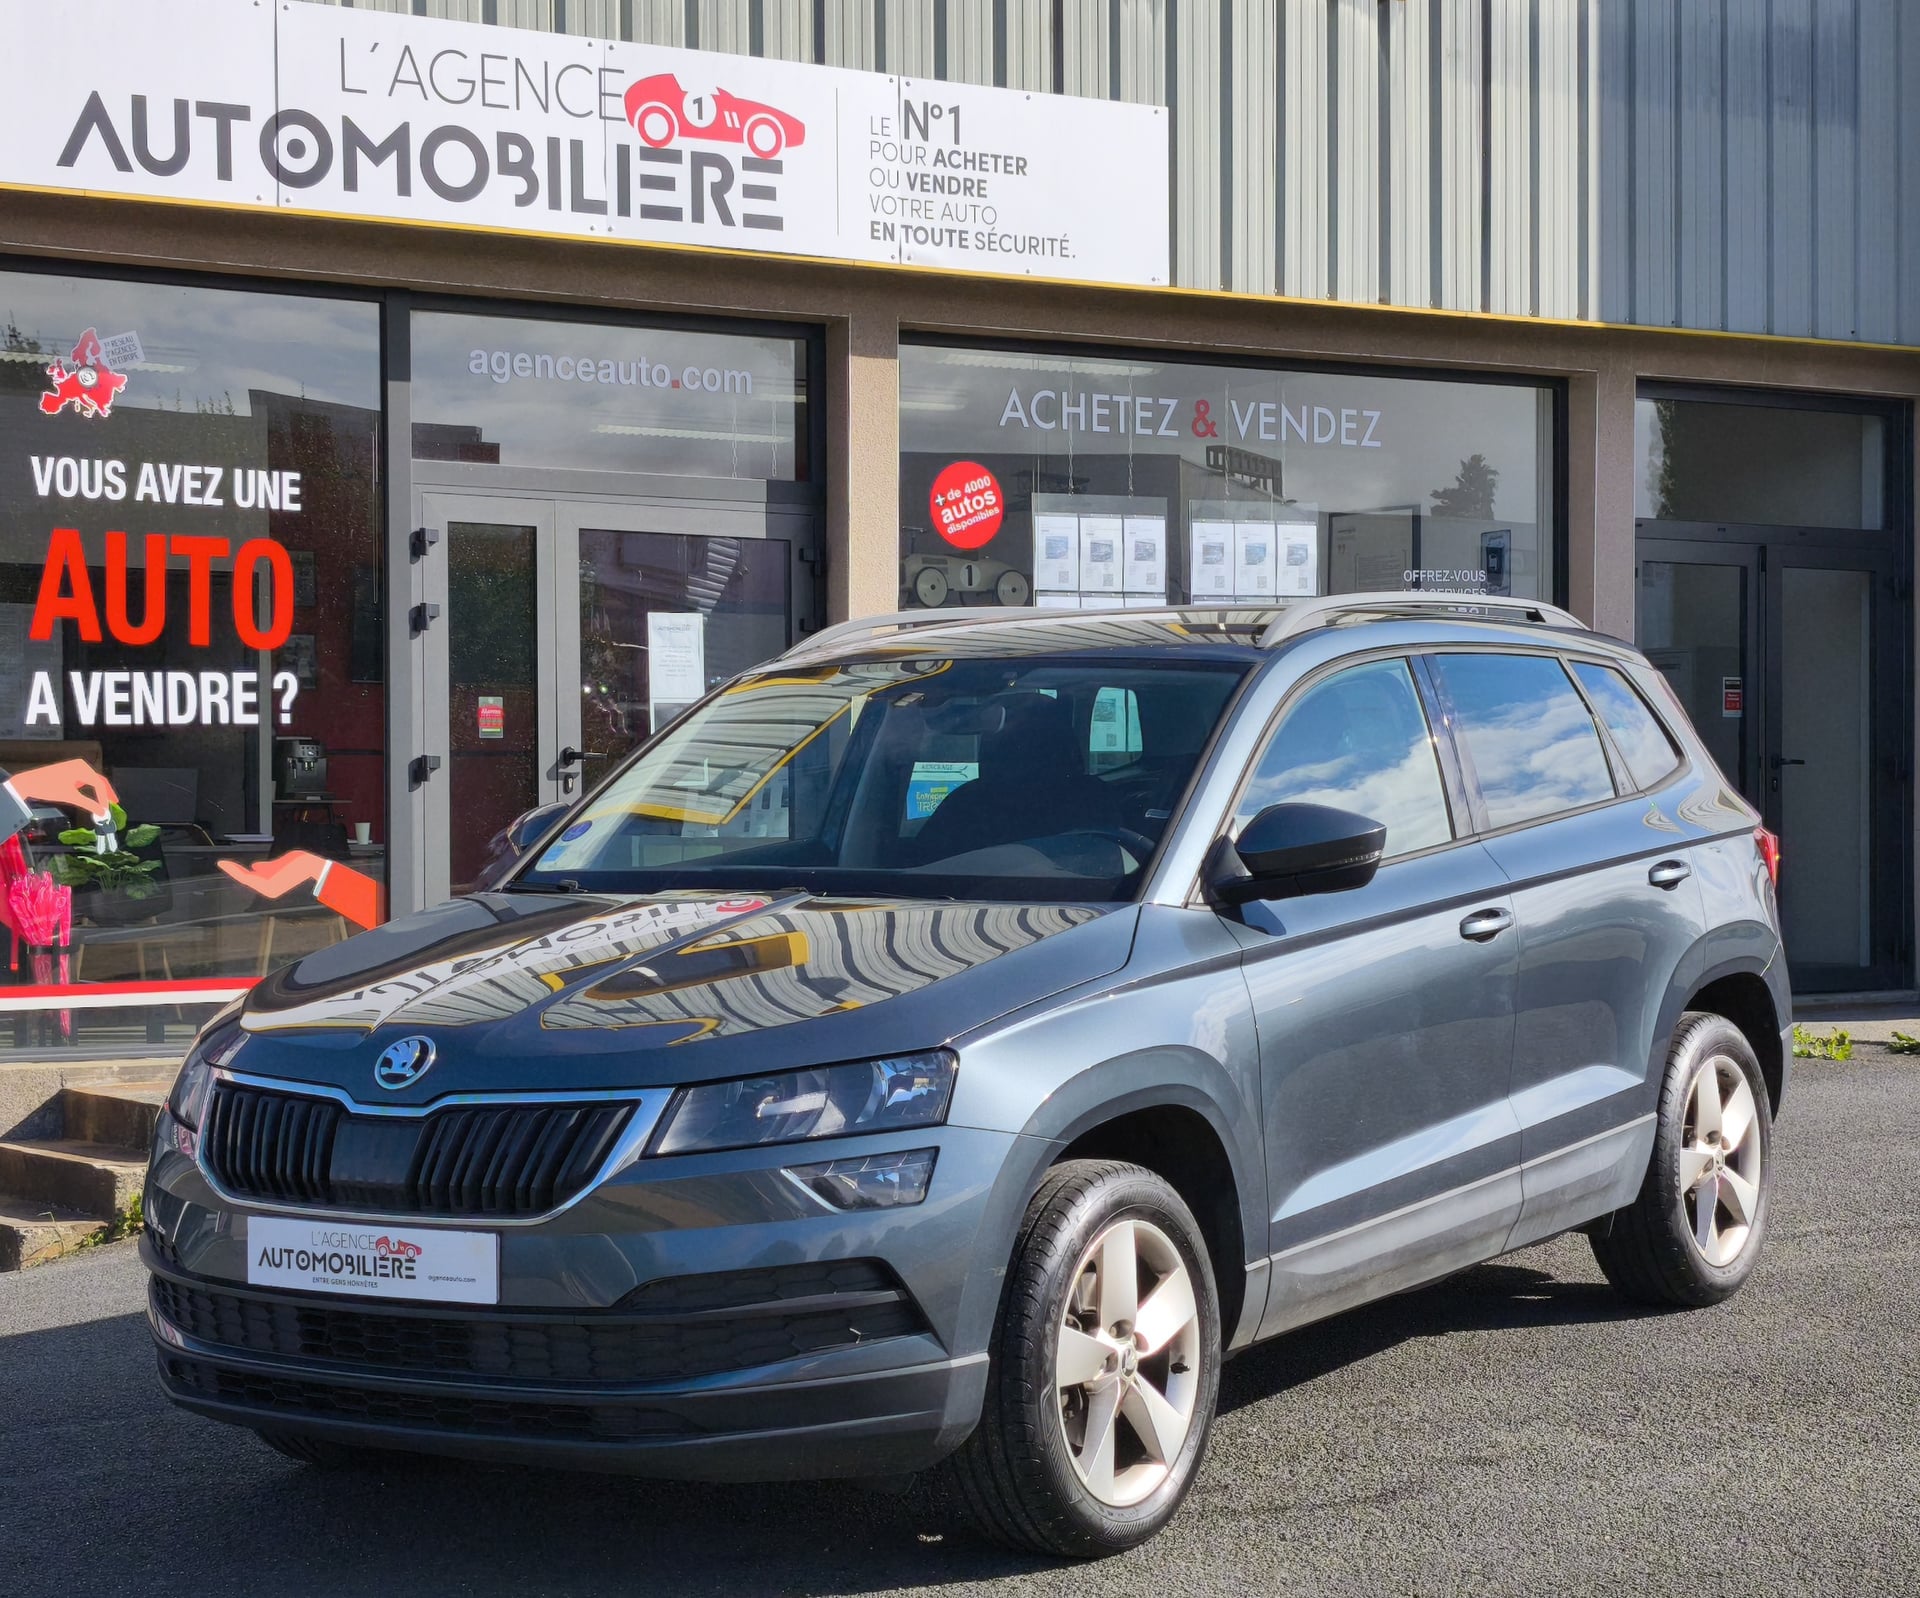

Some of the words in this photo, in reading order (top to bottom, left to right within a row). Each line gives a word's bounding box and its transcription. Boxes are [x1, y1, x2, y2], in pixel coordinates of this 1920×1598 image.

[340, 37, 626, 122] L'AGENCE
[870, 115, 891, 137] LE
[870, 140, 927, 166] POUR
[933, 148, 1028, 176] ACHETER
[869, 168, 899, 189] OU
[906, 171, 988, 198] VENDRE
[869, 194, 934, 220] VOTRE
[941, 202, 997, 225] AUTO
[870, 221, 895, 242] EN
[900, 224, 969, 249] TOUTE
[975, 227, 1076, 258] SÉCURITÉ.
[468, 349, 752, 394] agenceauto.com
[999, 387, 1179, 437] ACHETEZ
[1191, 400, 1218, 438] &
[1230, 399, 1382, 448] VENDEZ
[30, 455, 126, 500] VOUS
[135, 462, 223, 506] AVEZ
[233, 468, 302, 512] UNE
[947, 488, 962, 501] de
[964, 475, 992, 495] 4000
[941, 490, 997, 524] autos
[947, 506, 1000, 535] disponibles
[29, 528, 294, 651] AUTO
[965, 564, 974, 587] 1
[1403, 569, 1487, 582] OFFREZ-VOUS
[25, 671, 61, 725] A
[69, 671, 259, 725] VENDRE
[273, 671, 298, 725] ?
[311, 1230, 377, 1251] L'AGENCE
[312, 1276, 330, 1285] ENTRE
[331, 1278, 346, 1286] GENS
